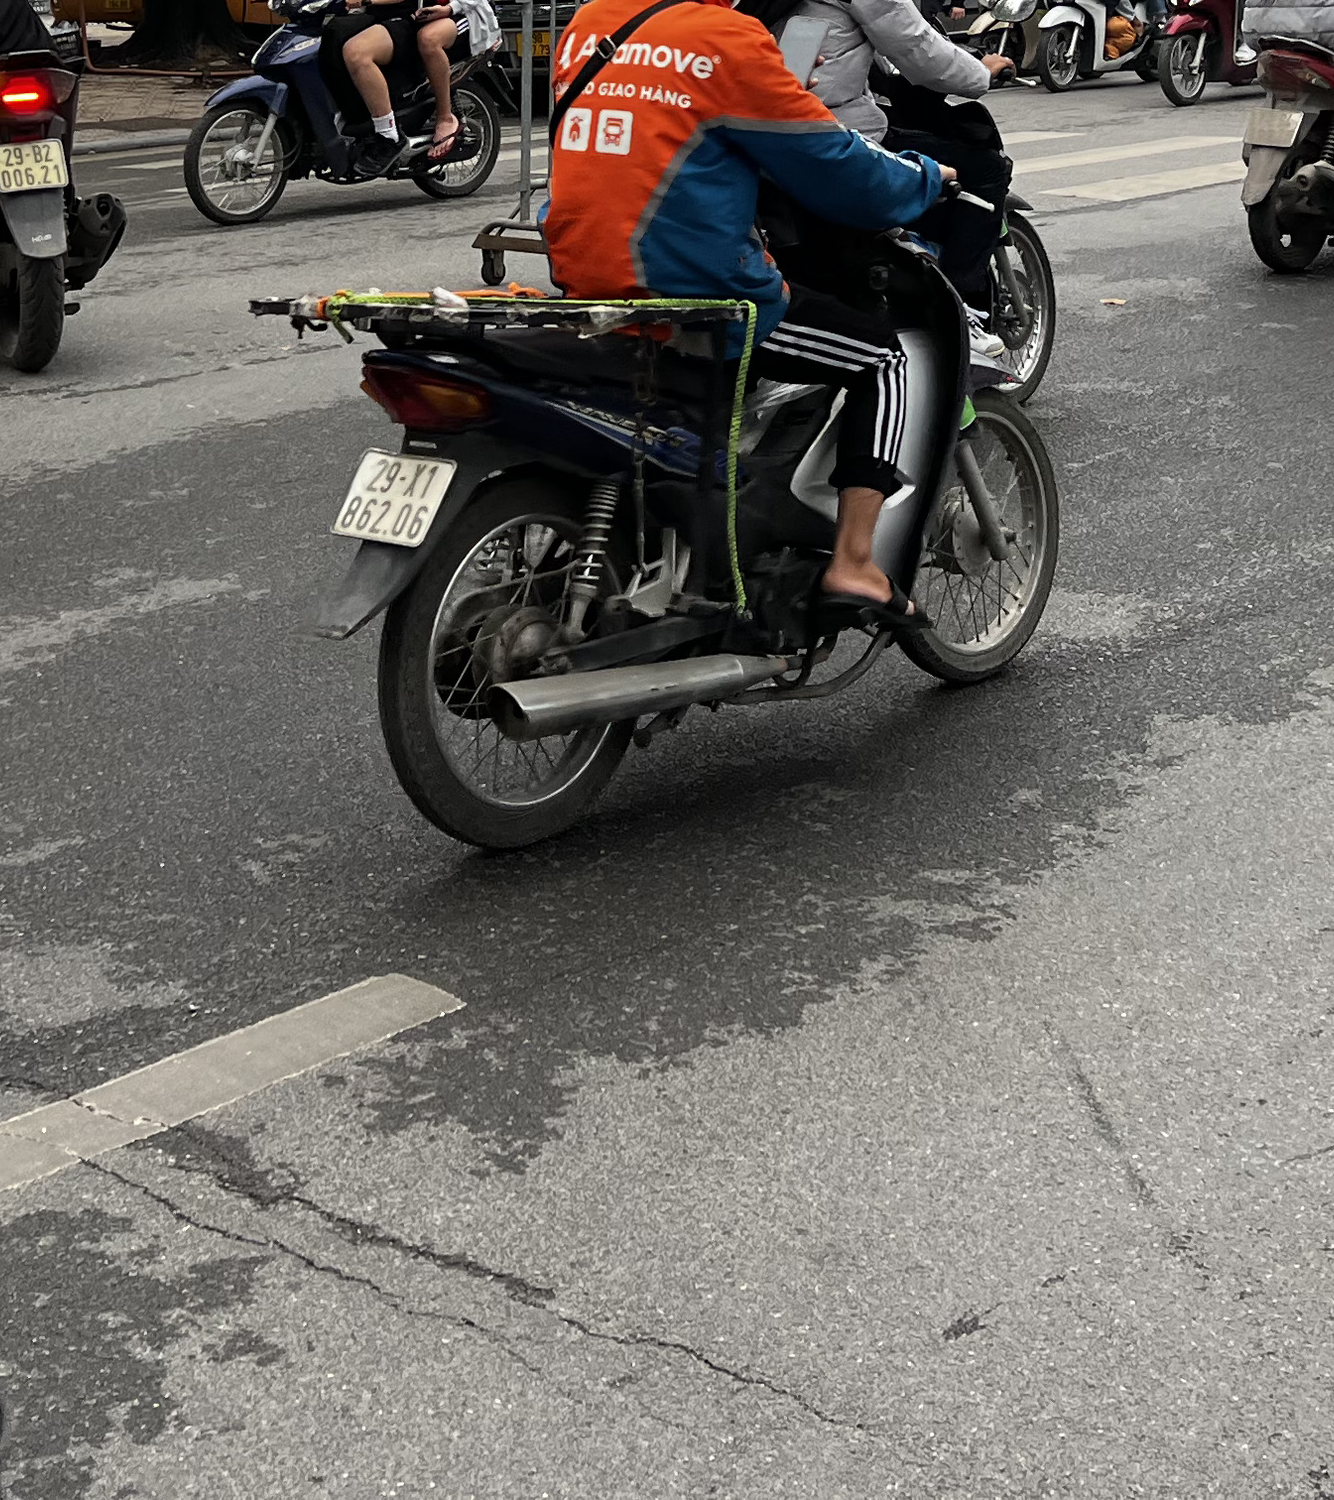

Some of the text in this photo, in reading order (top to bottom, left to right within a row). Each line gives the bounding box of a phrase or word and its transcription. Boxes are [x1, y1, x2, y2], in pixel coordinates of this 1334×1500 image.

[577, 32, 714, 80] Aamove
[598, 82, 636, 98] GIAO
[2, 144, 54, 167] 29-B2
[1, 164, 62, 188] 006.21
[365, 458, 440, 499] 29-X1
[341, 495, 429, 540] 862.06
